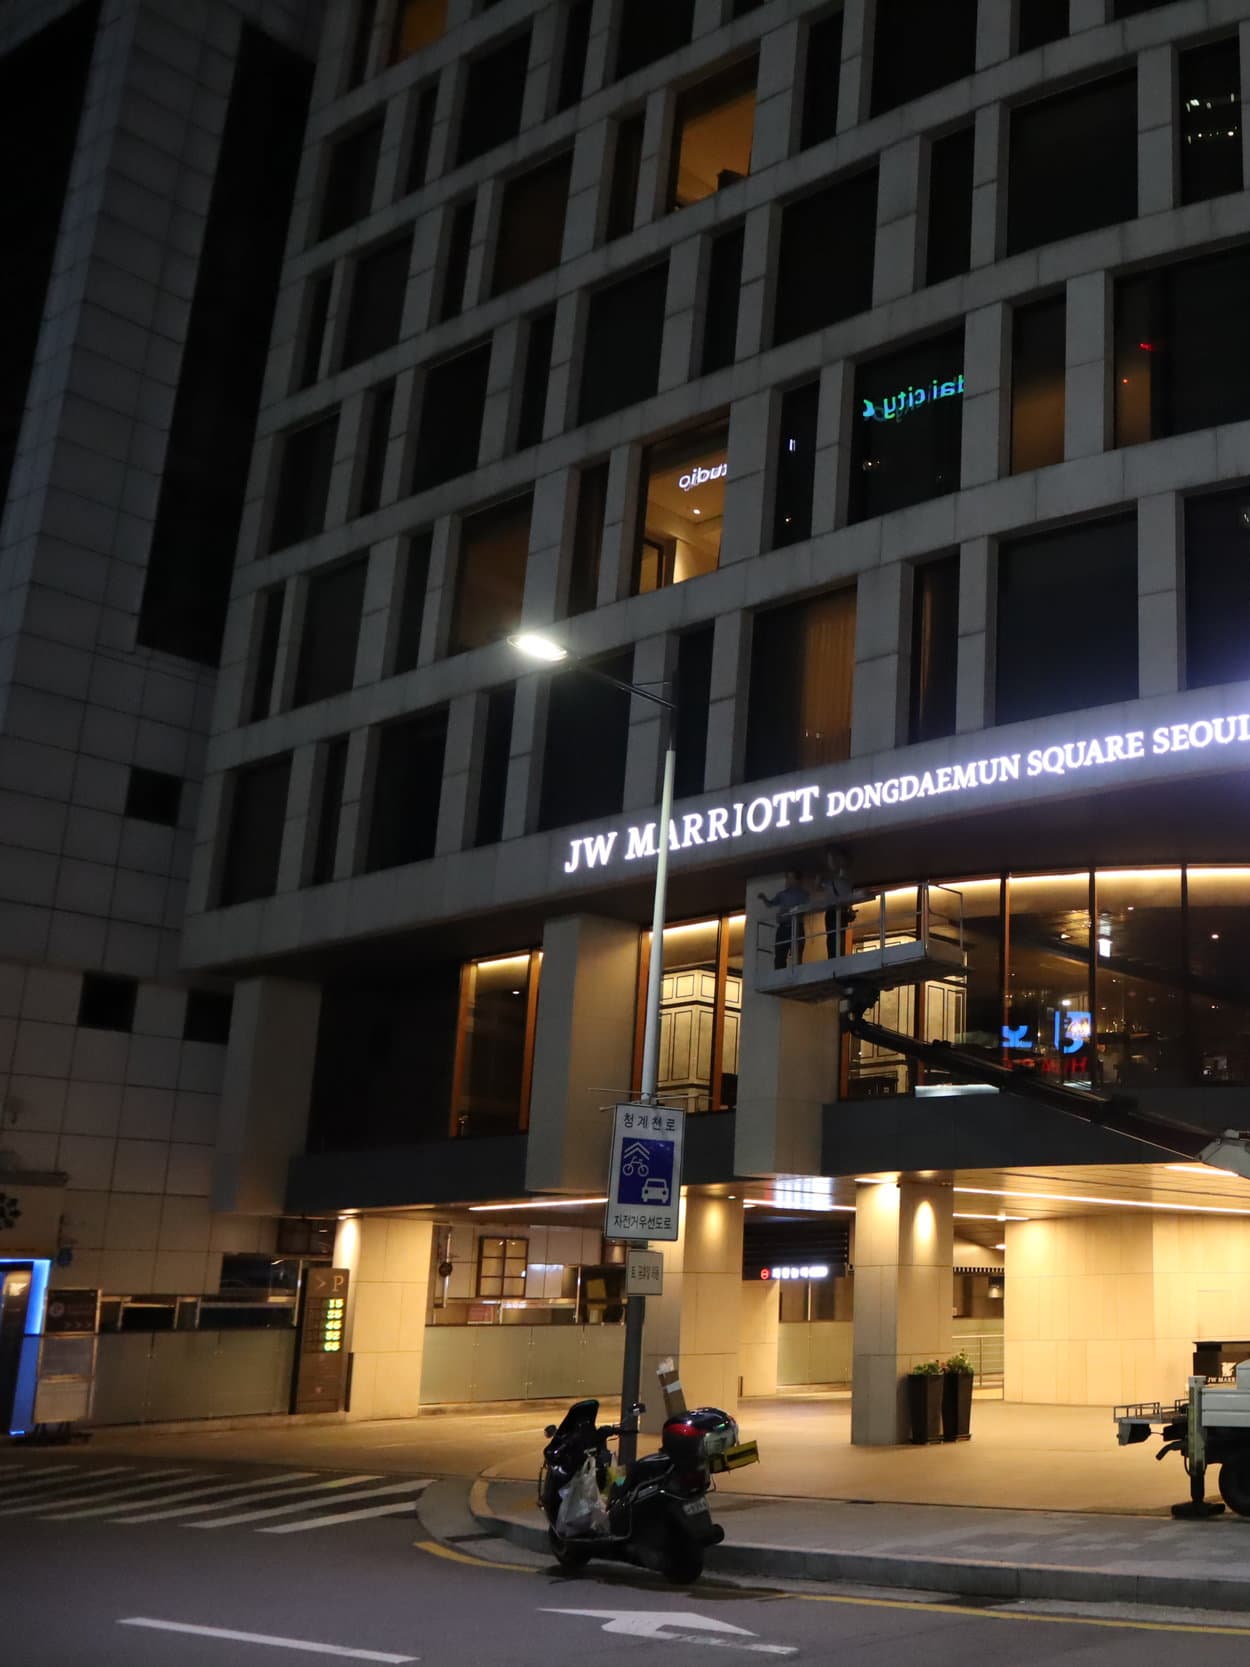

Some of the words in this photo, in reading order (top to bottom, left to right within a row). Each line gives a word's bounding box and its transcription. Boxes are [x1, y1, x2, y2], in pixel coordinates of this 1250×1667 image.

[564, 831, 618, 873] JW
[624, 785, 819, 850] MARRIOTT
[826, 752, 1020, 817] DONGDAEMUN
[1027, 731, 1145, 777] SQUARE
[623, 1112, 676, 1132] 청계천로
[613, 1215, 673, 1231] 자전거우선도로
[332, 1275, 344, 1292] P
